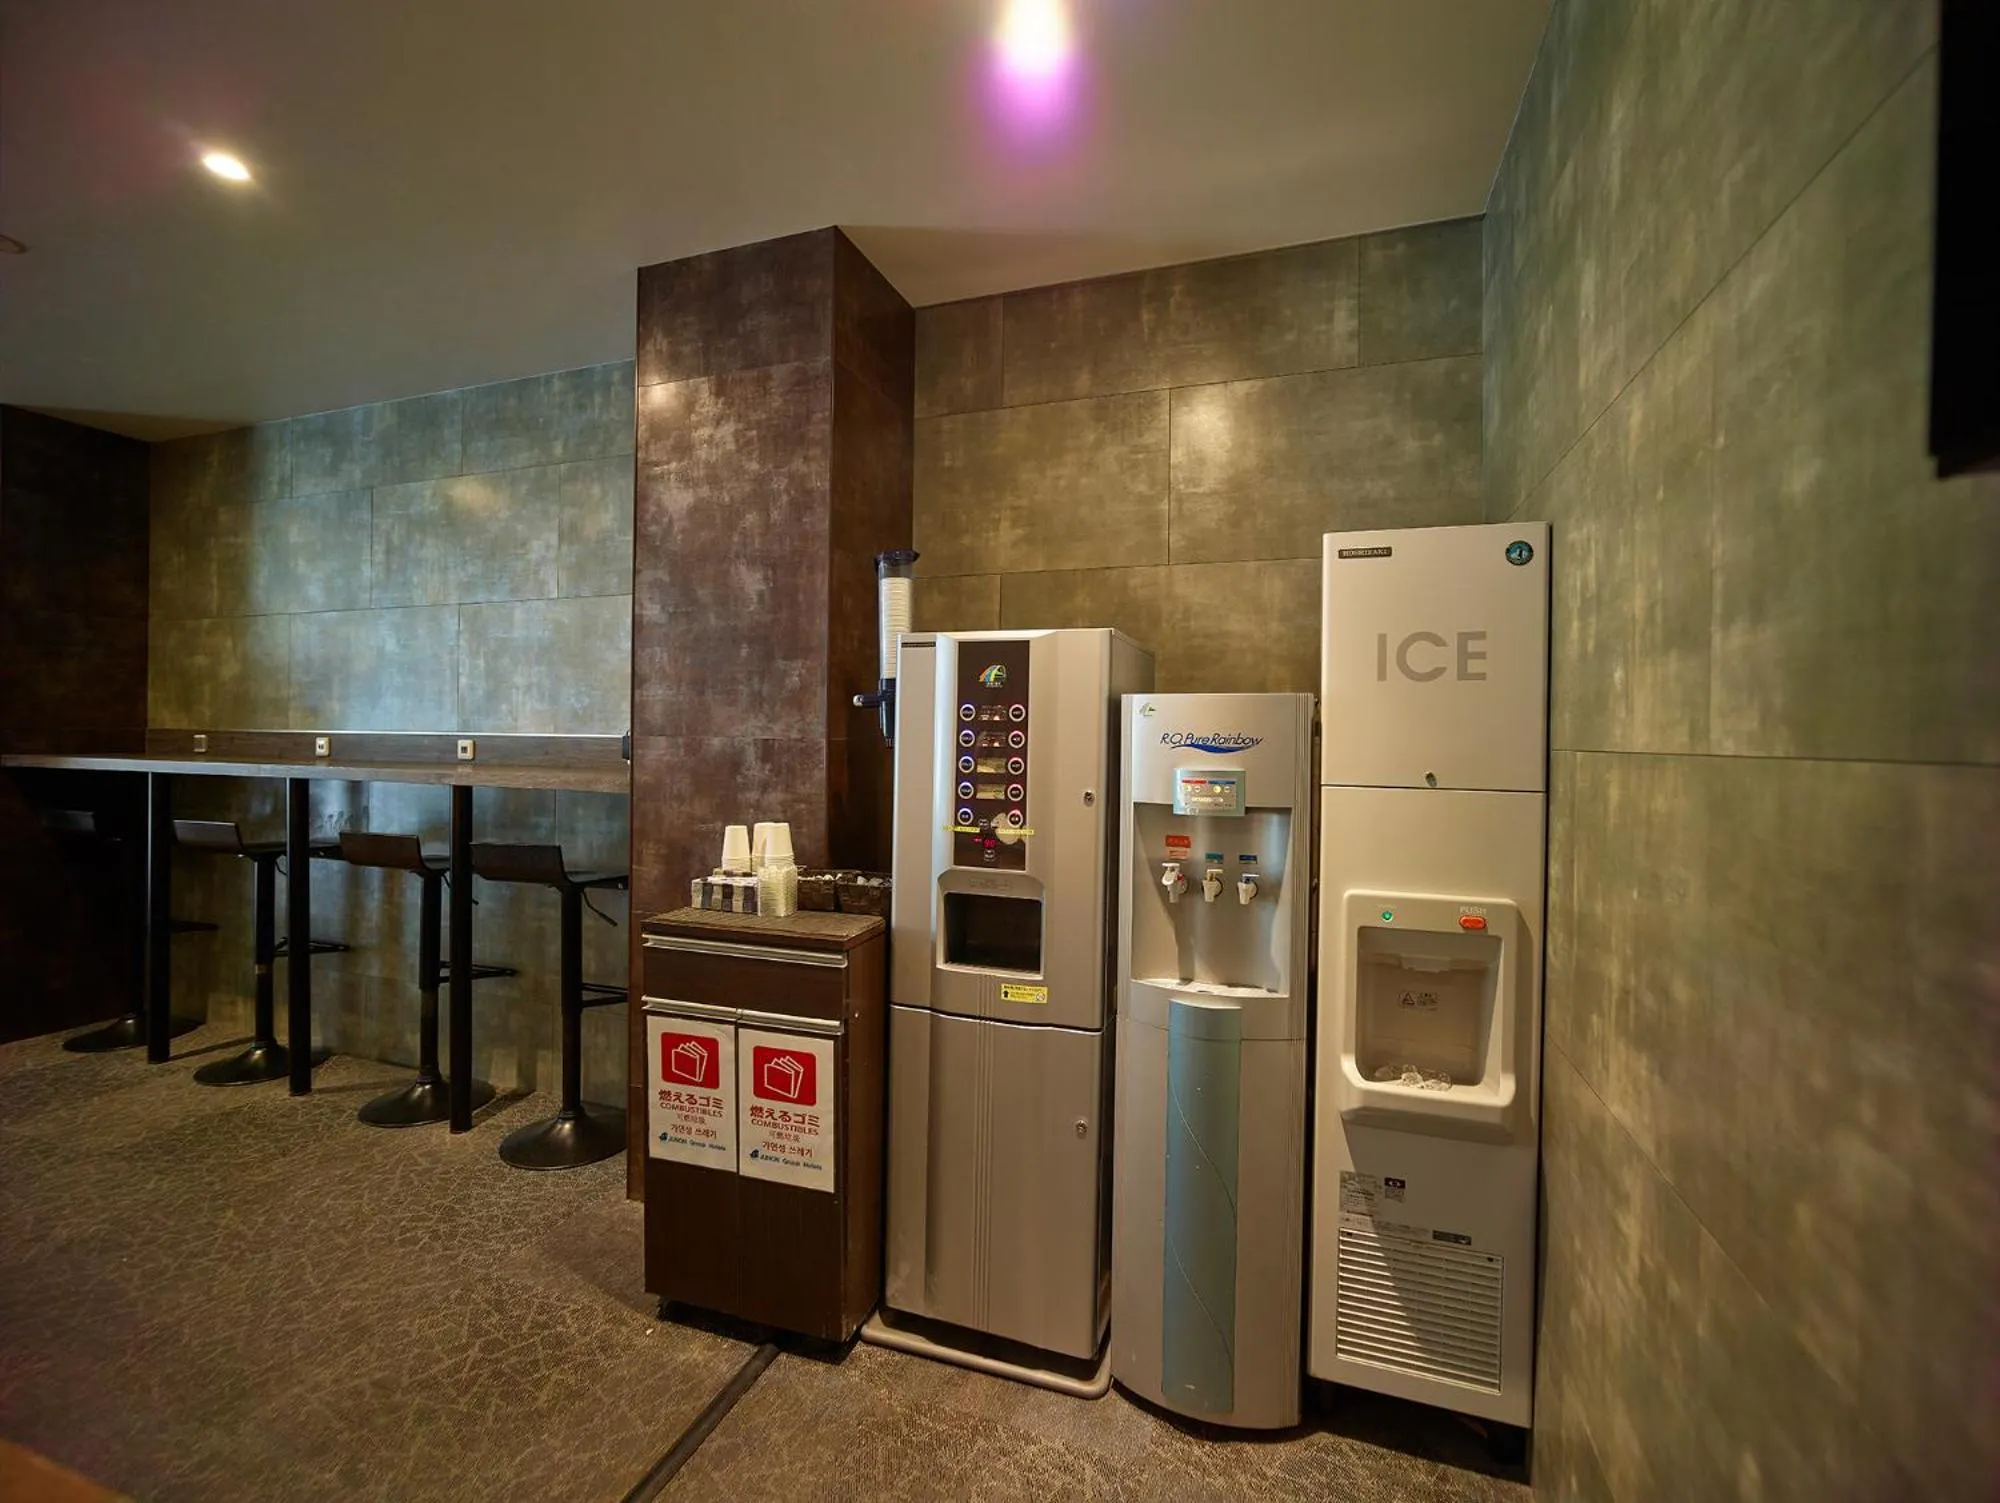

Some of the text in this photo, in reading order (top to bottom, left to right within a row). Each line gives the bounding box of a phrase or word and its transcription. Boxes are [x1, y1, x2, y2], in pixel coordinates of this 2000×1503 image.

[1377, 631, 1487, 682] ICE
[1184, 732, 1210, 745] Pure
[1210, 732, 1264, 745] Rainbow
[1460, 905, 1487, 915] PUSH
[658, 1089, 723, 1110] 燃えるゴミ
[660, 1102, 723, 1118] COMBUSTIBLES
[749, 1104, 820, 1128] 燃えるゴミ
[751, 1118, 819, 1136] COMBUSTIBLES
